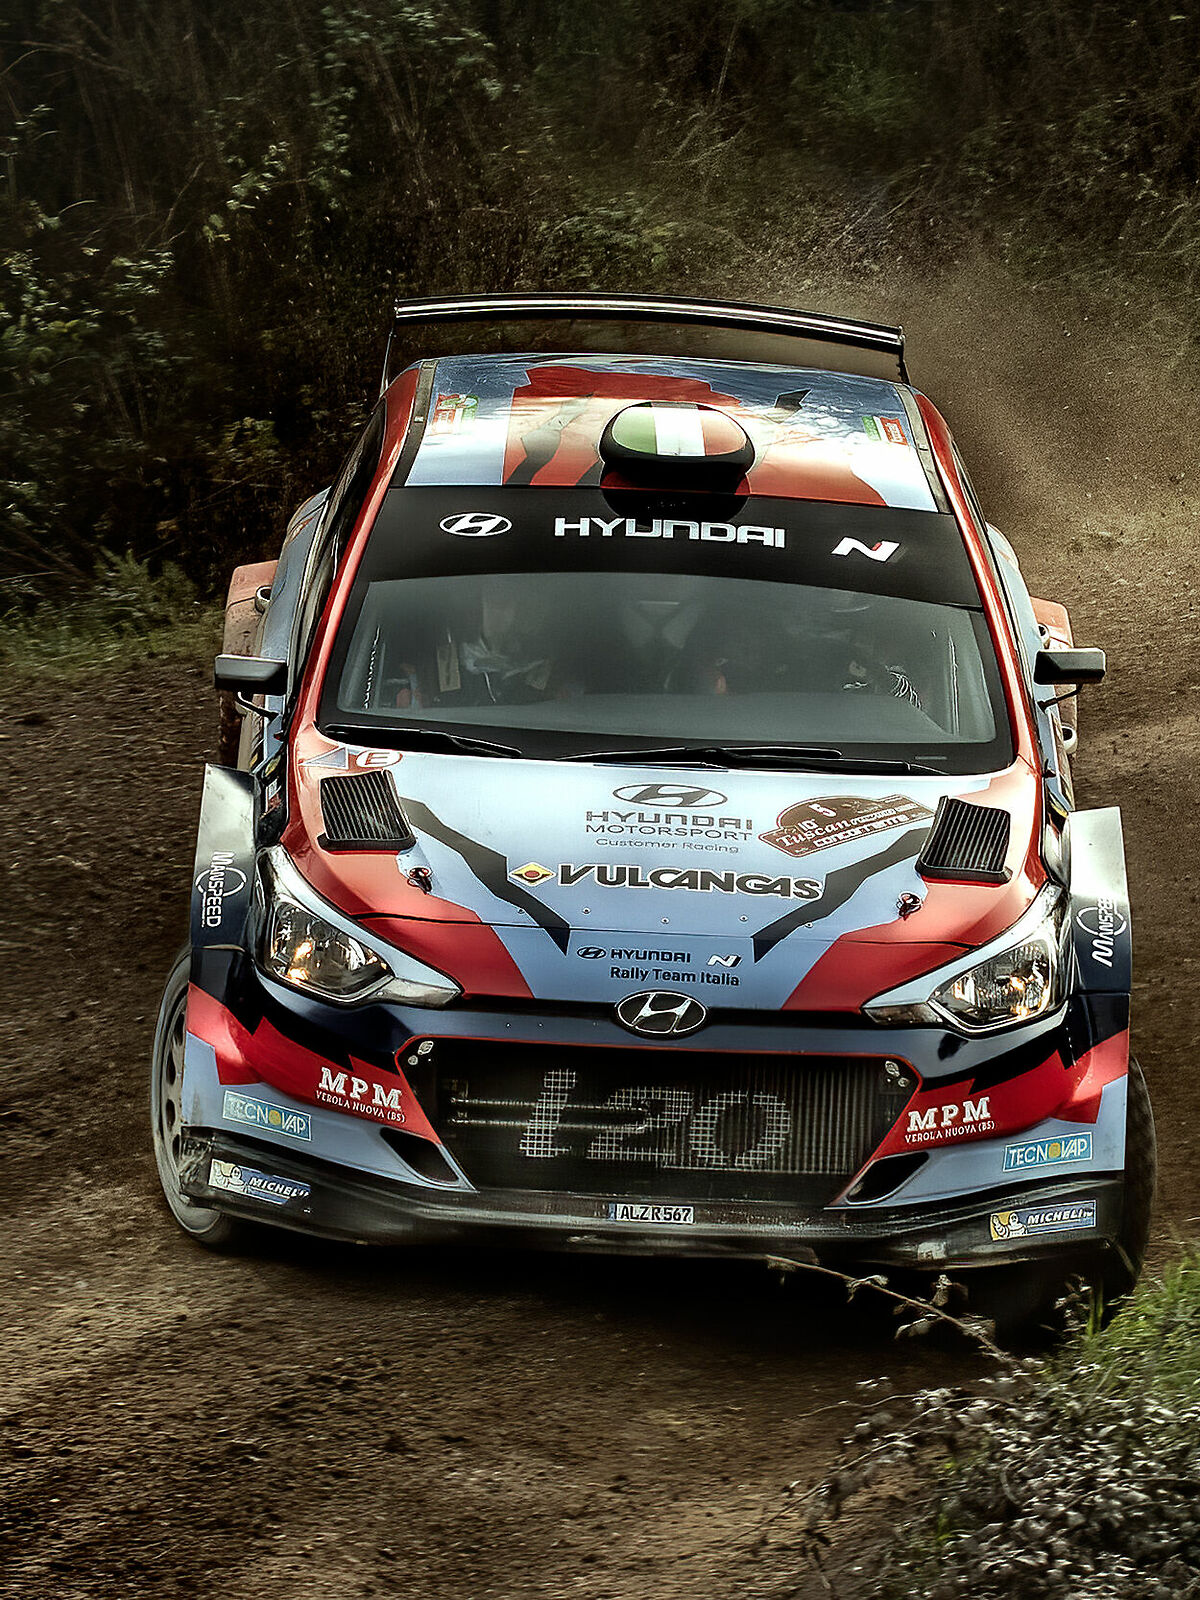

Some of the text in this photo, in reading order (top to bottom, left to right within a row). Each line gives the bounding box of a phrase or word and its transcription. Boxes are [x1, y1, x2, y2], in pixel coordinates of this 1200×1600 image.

[554, 517, 785, 548] HYUNDAI
[586, 811, 753, 830] HYUNDAI
[586, 824, 753, 841] MOTORSPORT
[596, 838, 740, 854] Customer Racing
[560, 864, 823, 899] VULCANGAS
[610, 948, 691, 963] HYUNDAI
[610, 966, 740, 986] Rally Team Italia
[315, 1090, 350, 1109] VEROLA
[352, 1101, 385, 1119] NUOVA
[904, 1131, 943, 1144] VEROLA
[945, 1126, 977, 1138] NUOVA
